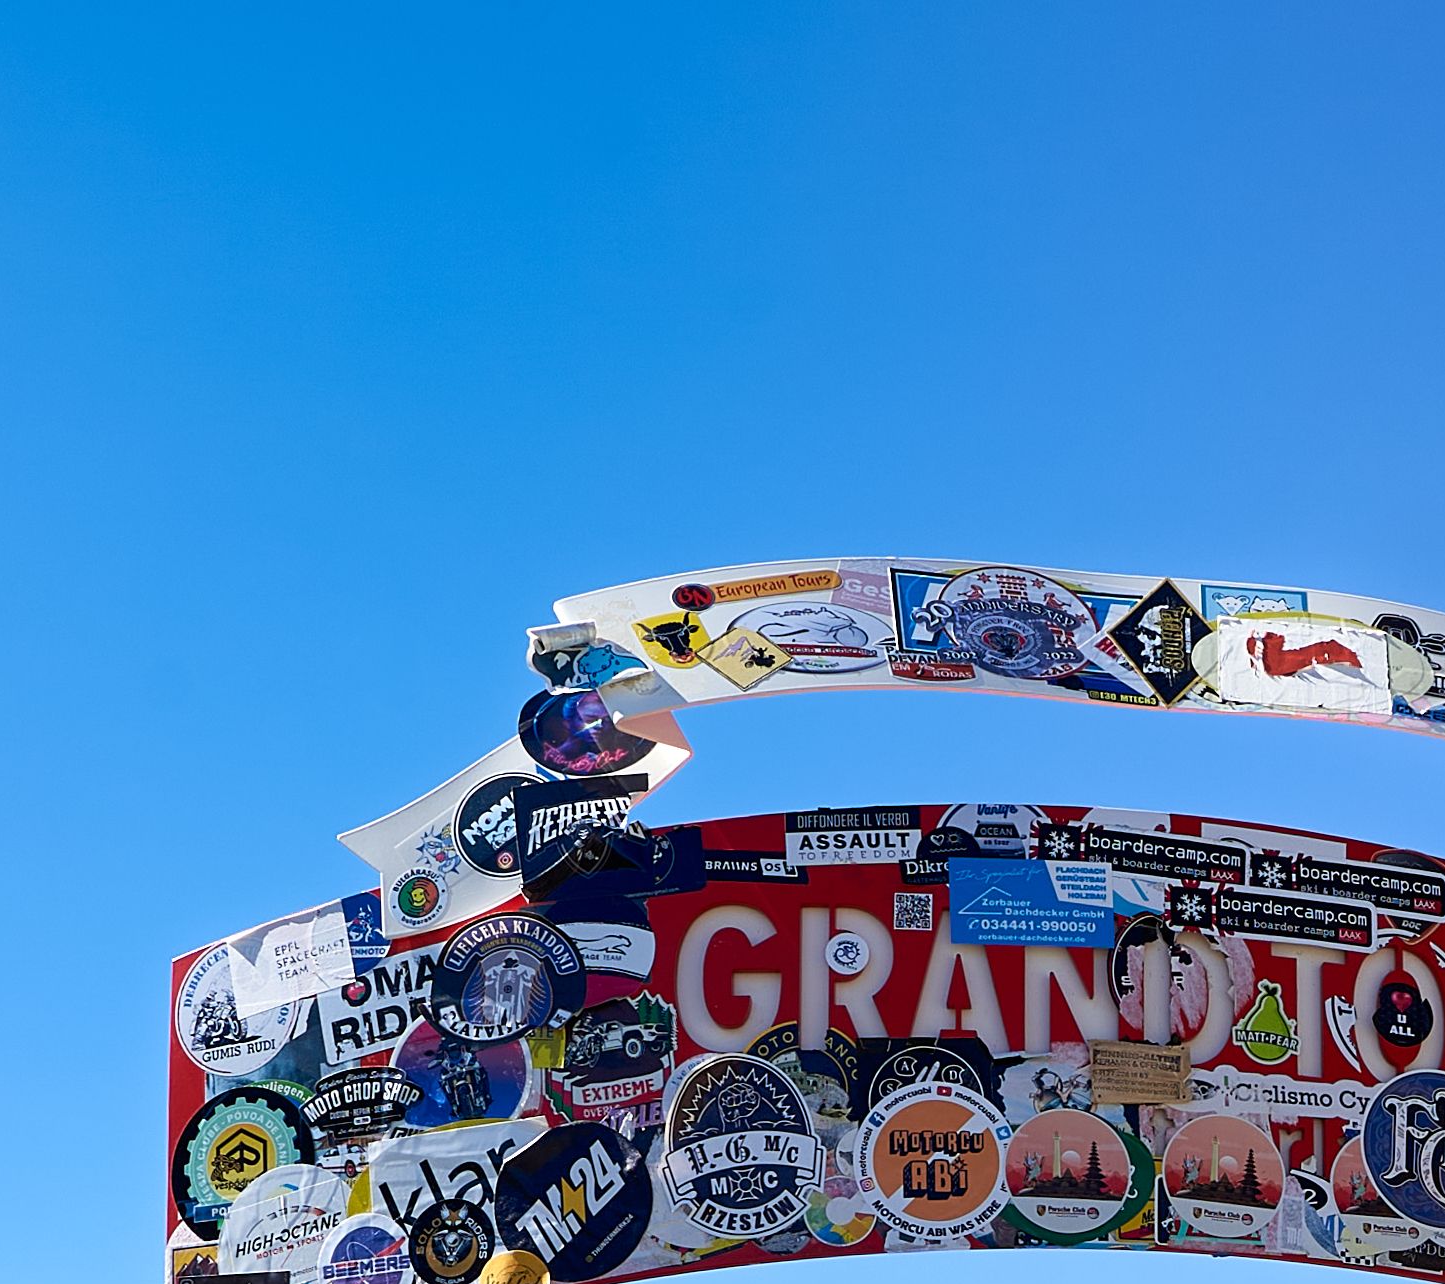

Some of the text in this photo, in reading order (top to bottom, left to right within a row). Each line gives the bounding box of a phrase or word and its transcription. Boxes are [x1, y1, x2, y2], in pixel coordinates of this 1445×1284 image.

[716, 573, 832, 600] European Tours
[915, 601, 954, 632] 20
[943, 650, 978, 661] 2002
[1041, 650, 1077, 661] 2022
[932, 668, 973, 679] RODAS
[797, 811, 910, 830] DIFFONDERE IL VERBO
[977, 802, 1018, 818] Vanlife
[798, 831, 912, 852] ASSAULT
[980, 827, 1014, 838] OCEAN
[1089, 832, 1242, 868] boardercamp.com
[1055, 866, 1107, 876] FLACHDACH
[1122, 857, 1171, 873] boarder
[1173, 864, 1207, 879] camps
[1210, 871, 1235, 883] LAAX
[1299, 861, 1442, 899] boardercamp.com
[1059, 883, 1108, 893] STEILDACH
[1067, 891, 1107, 901] HOLZBAU
[981, 897, 1032, 908] Zorbauer
[1004, 907, 1105, 919] Dachdecker GmbH
[1219, 894, 1368, 928] boardercamp.com
[1379, 895, 1411, 909] camps
[1413, 898, 1436, 911] LAAX
[980, 918, 1097, 934] 034441-990050
[1220, 916, 1239, 926] ski
[1255, 919, 1301, 934] boarder
[1303, 926, 1336, 940] camps
[1338, 930, 1363, 942] LAAX
[603, 953, 623, 962] TEAM
[278, 966, 309, 982] TEAM
[1389, 1024, 1416, 1038] ALL
[201, 1038, 277, 1064] GUMIS RUDI
[304, 1081, 422, 1123] MOTO CHOP SHOP
[582, 1077, 655, 1102] EXTREME
[883, 1086, 933, 1111] motorcuabi
[1234, 1082, 1334, 1108] Ciclismo
[954, 1090, 1000, 1124] motorcuabi
[196, 1125, 221, 1161] CLUBE
[226, 1109, 265, 1124] PÓVOA
[889, 1129, 985, 1156] MOTORCU
[860, 1127, 873, 1177] motorcuabi
[701, 1194, 797, 1232] RZESZÓW
[871, 1199, 1002, 1238] MOTORCU ABI WAS HERE
[235, 1211, 343, 1259] HIGH-OCTANE
[256, 1234, 325, 1260] MOTOR SPORTS
[415, 1216, 488, 1260] SOLO RIDERS
[322, 1254, 412, 1280] BEEMERS
